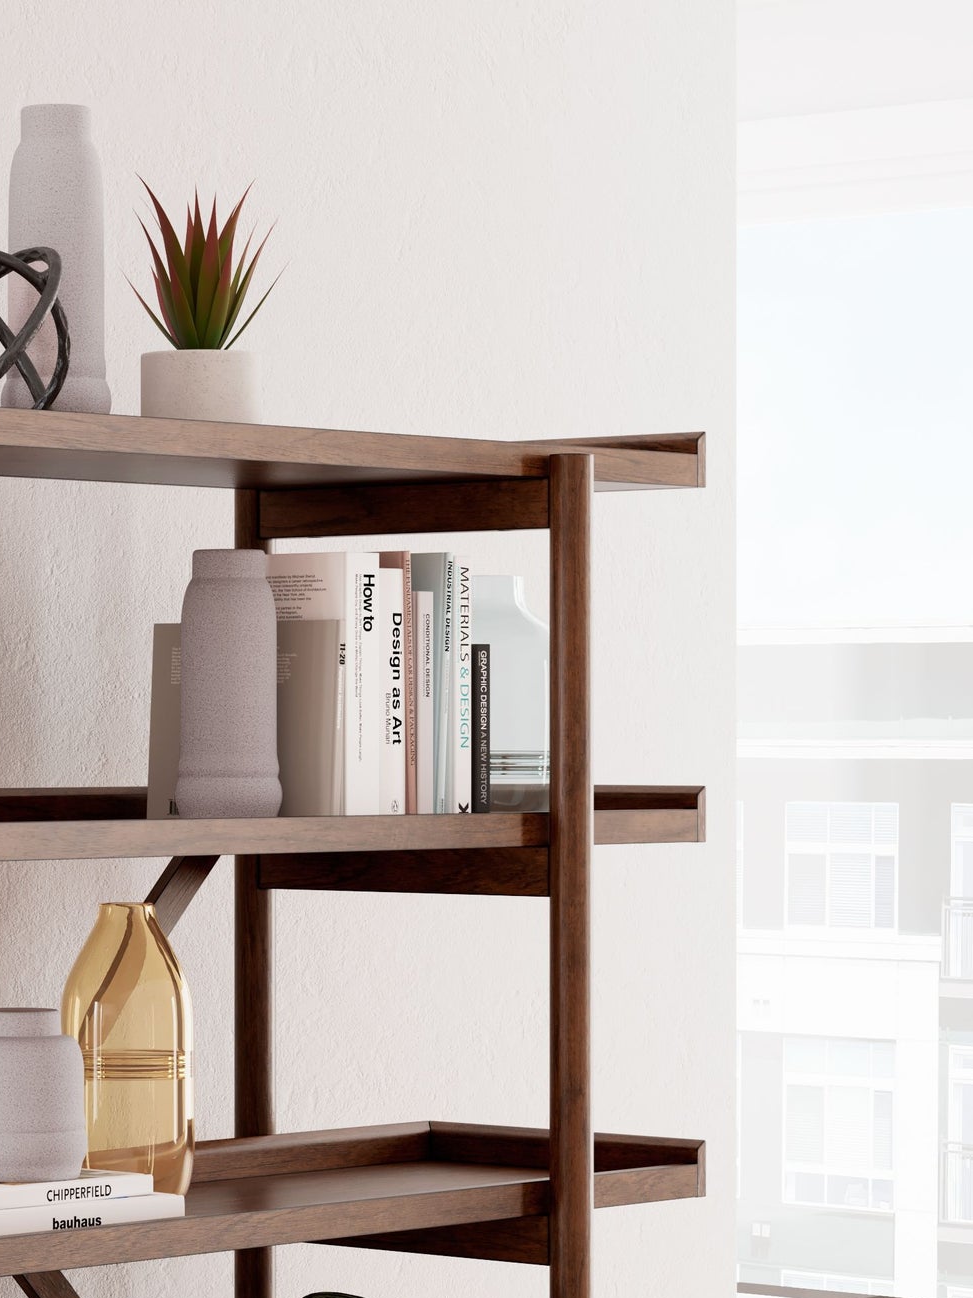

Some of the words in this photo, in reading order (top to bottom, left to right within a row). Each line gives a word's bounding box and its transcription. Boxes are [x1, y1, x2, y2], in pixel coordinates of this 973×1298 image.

[363, 574, 375, 612] How
[363, 616, 374, 632] to
[460, 567, 469, 662] MATERIALS
[390, 613, 402, 680] Design
[460, 667, 469, 679] &
[392, 687, 401, 710] as
[460, 684, 469, 748] DESIGN
[392, 716, 402, 745] Art
[480, 731, 487, 739] A
[46, 1184, 112, 1202] CHIPPERFIELD
[52, 1216, 102, 1230] bauhaus
